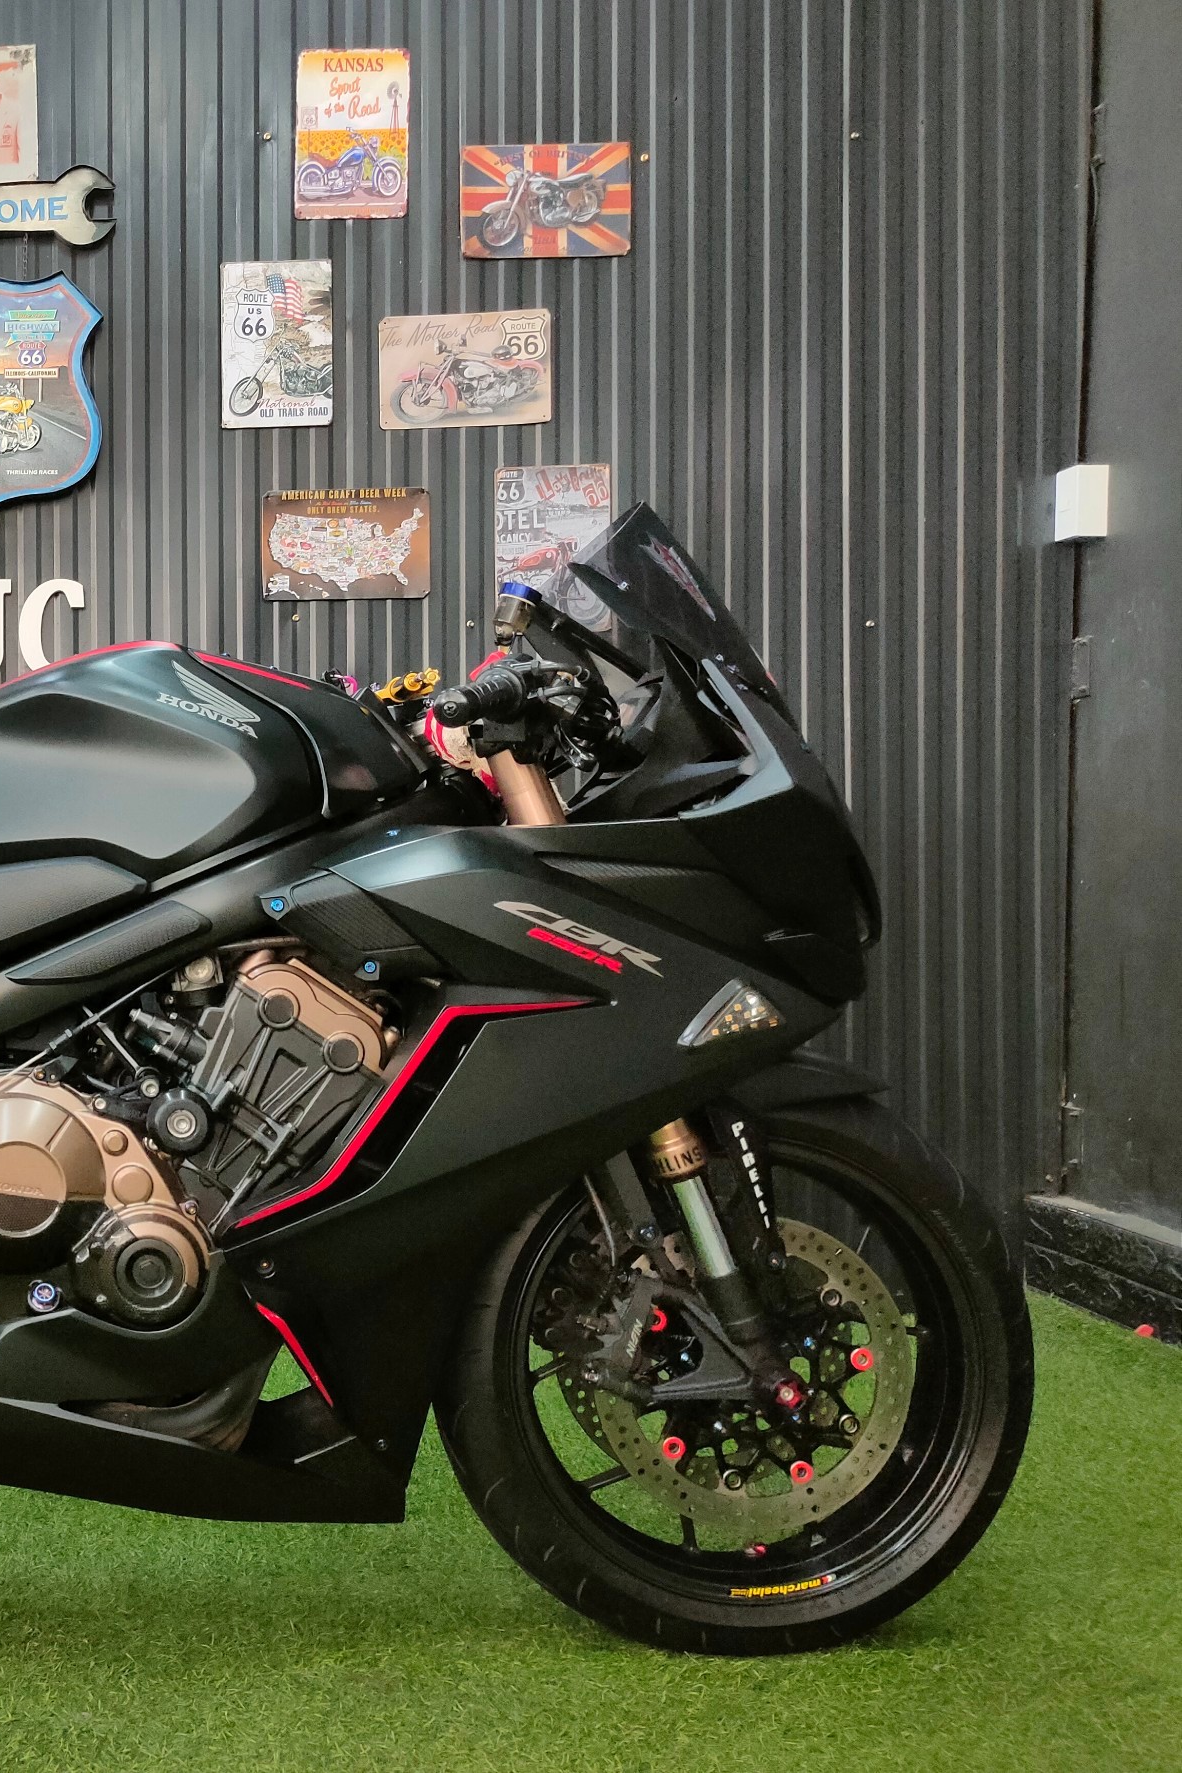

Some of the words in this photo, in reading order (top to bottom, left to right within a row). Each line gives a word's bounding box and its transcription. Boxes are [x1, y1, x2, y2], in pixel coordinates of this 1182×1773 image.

[323, 57, 384, 72] KANSAS
[329, 77, 361, 100] Spirit
[324, 103, 333, 118] of
[348, 95, 381, 120] Road
[243, 293, 268, 303] ROUTE
[8, 323, 57, 331] HIGHWAY
[242, 317, 267, 337] 66
[380, 325, 403, 351] The
[406, 320, 460, 347] Mother
[465, 314, 502, 335] Road
[511, 323, 536, 331] ROUTE
[507, 334, 539, 357] 66
[20, 350, 43, 365] 66
[258, 396, 316, 408] National
[260, 408, 274, 418] OLD
[278, 407, 304, 417] TRAILS
[307, 407, 329, 417] ROAD
[281, 490, 325, 500] AMERICAN
[328, 489, 355, 500] CRAFT
[359, 488, 380, 498] BEER
[383, 488, 407, 498] WEEK
[497, 482, 520, 501] 66
[156, 692, 258, 739] HONDA
[493, 900, 665, 978] CBR
[731, 1121, 770, 1229] PIRELLI
